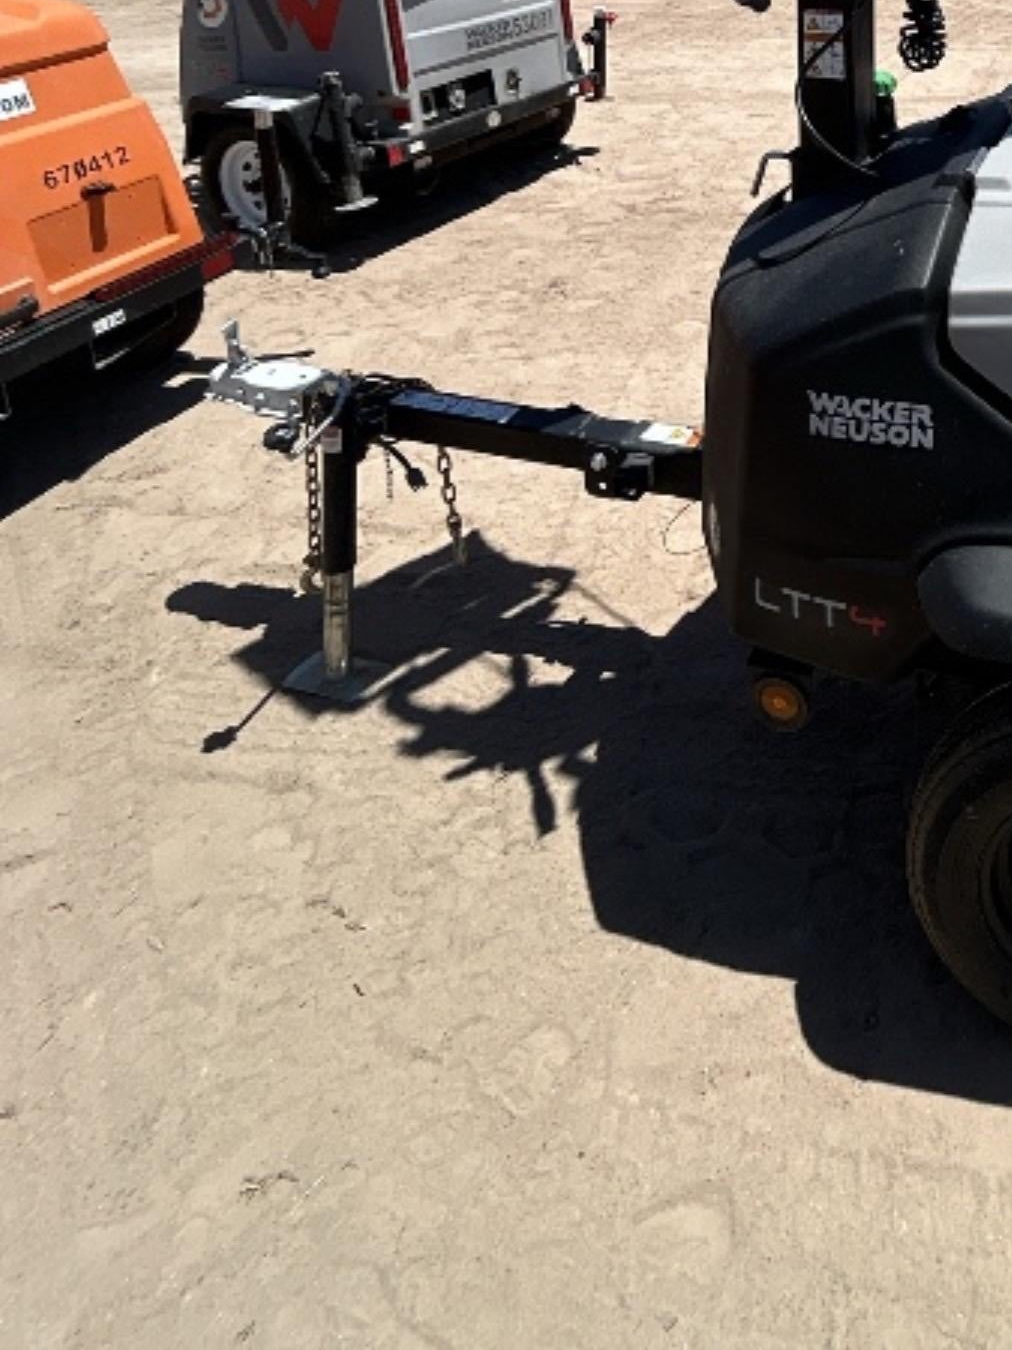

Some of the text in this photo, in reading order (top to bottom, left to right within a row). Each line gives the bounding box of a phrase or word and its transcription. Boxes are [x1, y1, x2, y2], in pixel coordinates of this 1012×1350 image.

[43, 146, 130, 189] 670412
[808, 390, 933, 427] WACKER
[809, 414, 933, 449] NEUSON
[755, 578, 886, 636] LTT4
